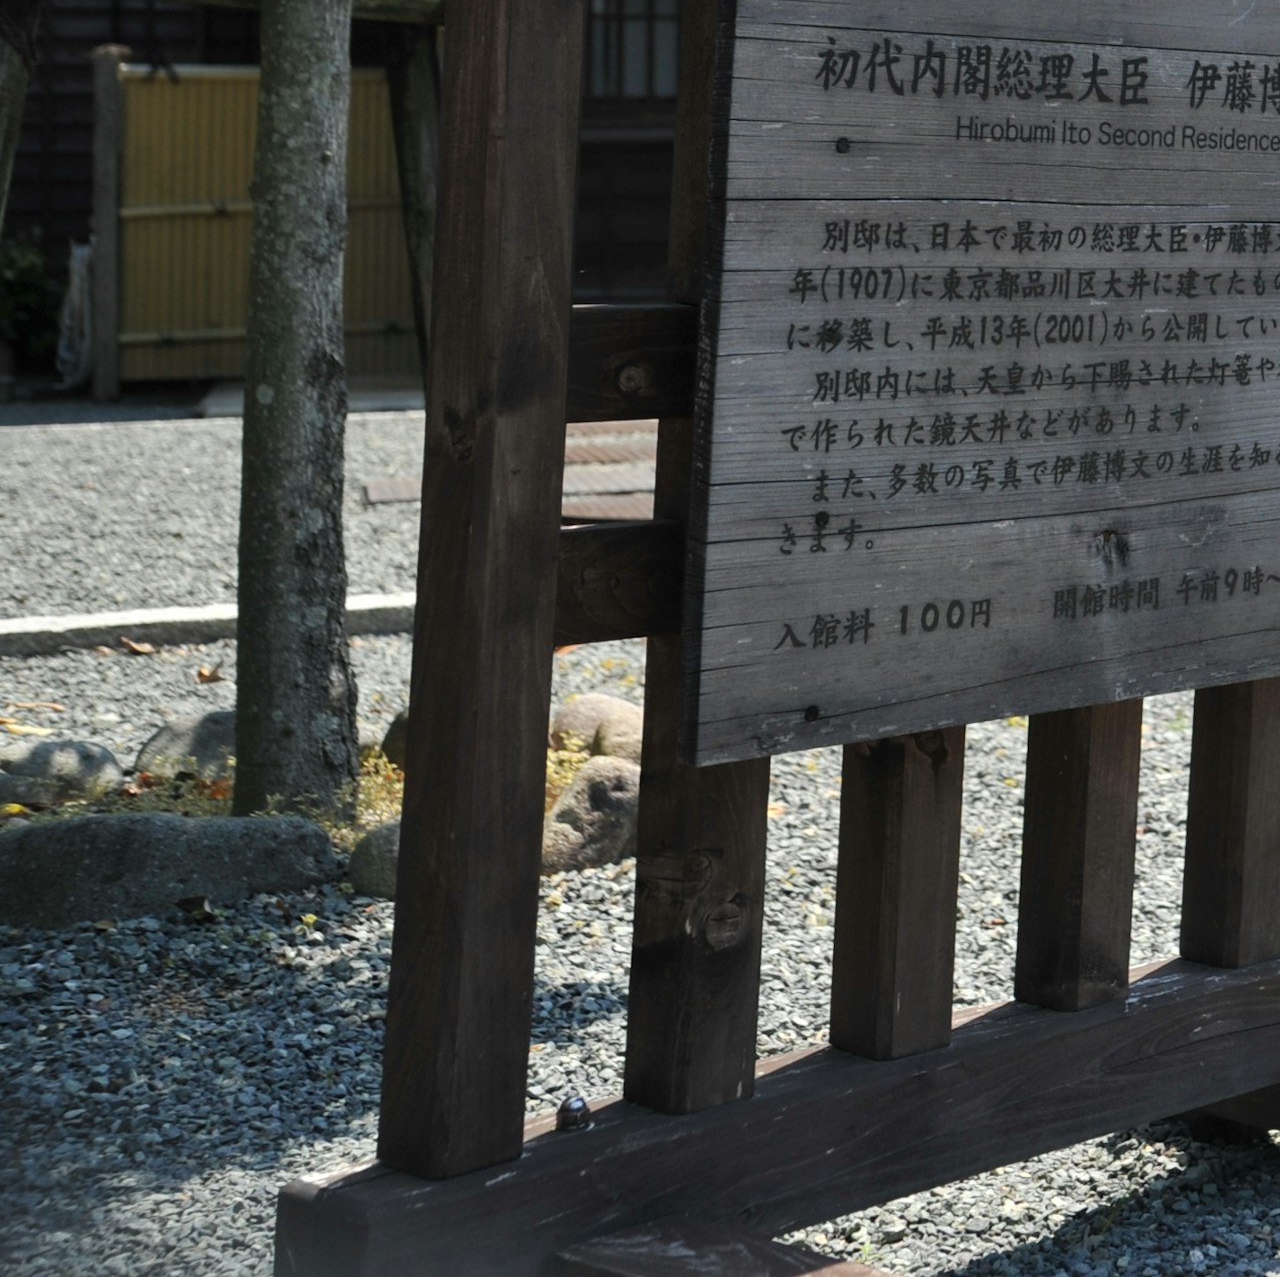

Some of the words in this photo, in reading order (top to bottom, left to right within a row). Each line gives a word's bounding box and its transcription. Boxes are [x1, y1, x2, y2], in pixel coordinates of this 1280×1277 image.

[814, 36, 1150, 106] 初代内閣総理大臣
[956, 116, 1056, 144] Hirobumi
[1062, 119, 1092, 145] Ito
[1098, 122, 1176, 149] Second
[1182, 125, 1280, 152] Residence
[781, 403, 1200, 452] で作られた鏡天井などがあります。
[779, 519, 873, 555] きます。
[1052, 577, 1160, 620] 開館時間
[774, 607, 875, 651] 入館料
[898, 598, 993, 636] 100円
